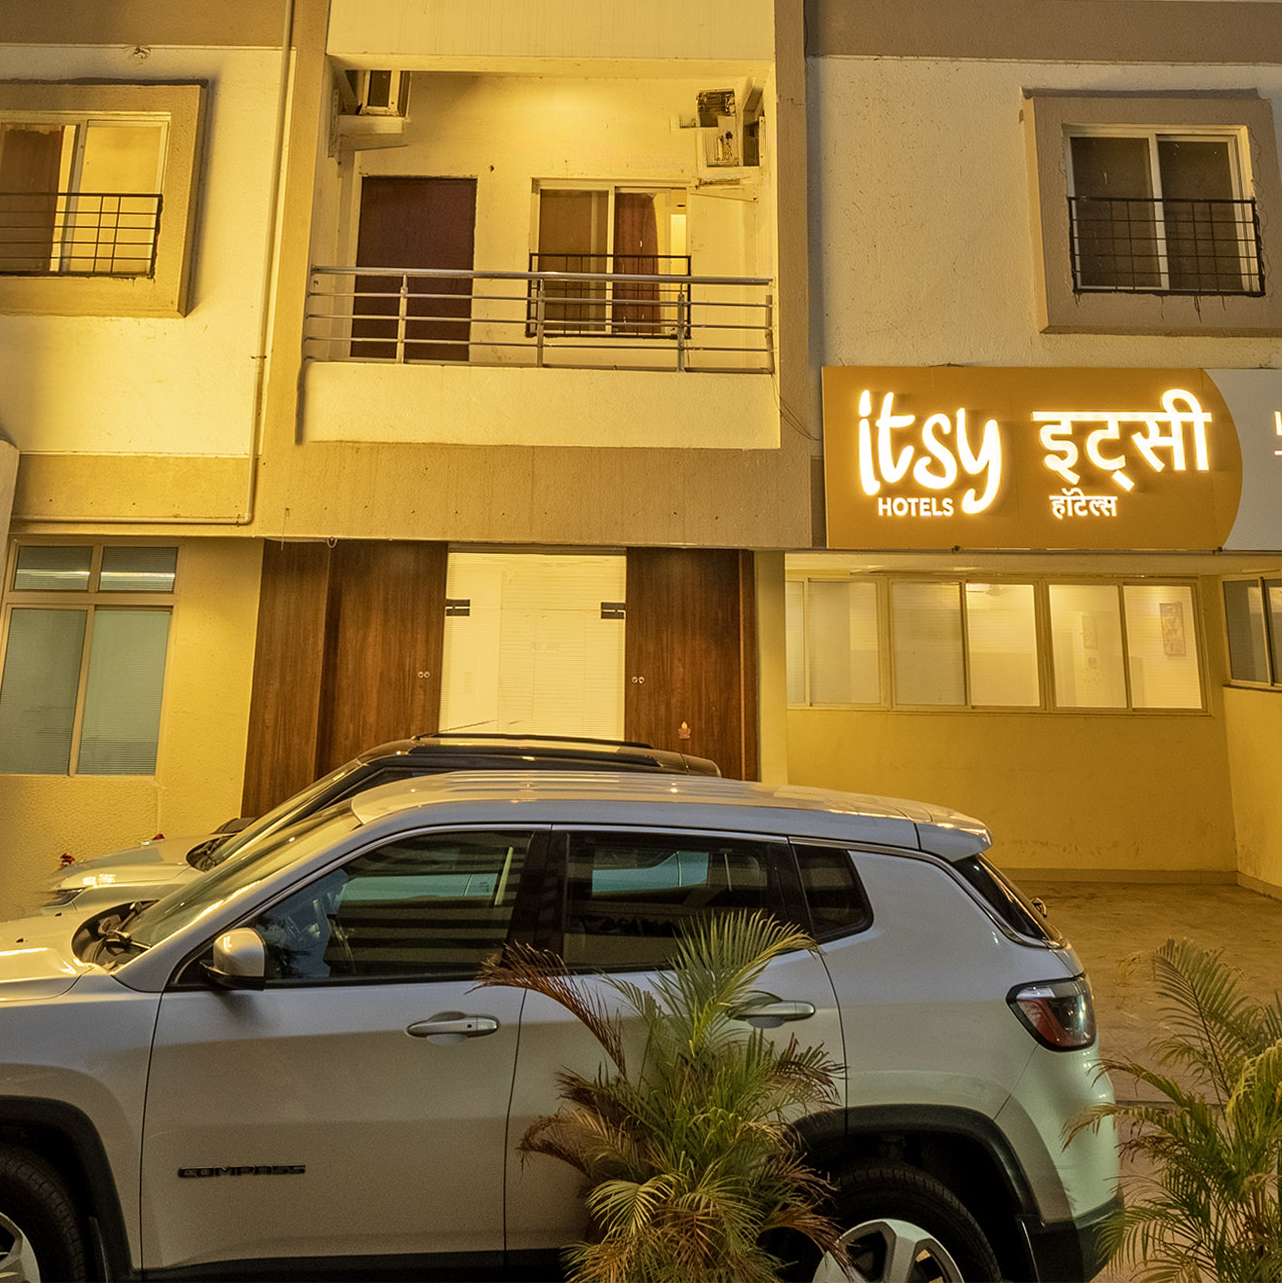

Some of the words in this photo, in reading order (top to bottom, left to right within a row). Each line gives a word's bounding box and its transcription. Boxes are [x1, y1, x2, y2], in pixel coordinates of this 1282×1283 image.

[858, 389, 1003, 515] itsy
[1031, 388, 1213, 492] इट्सी
[877, 497, 954, 517] HOTELS
[1049, 488, 1118, 519] हॉटेल्स
[178, 1164, 306, 1178] COMPASS
